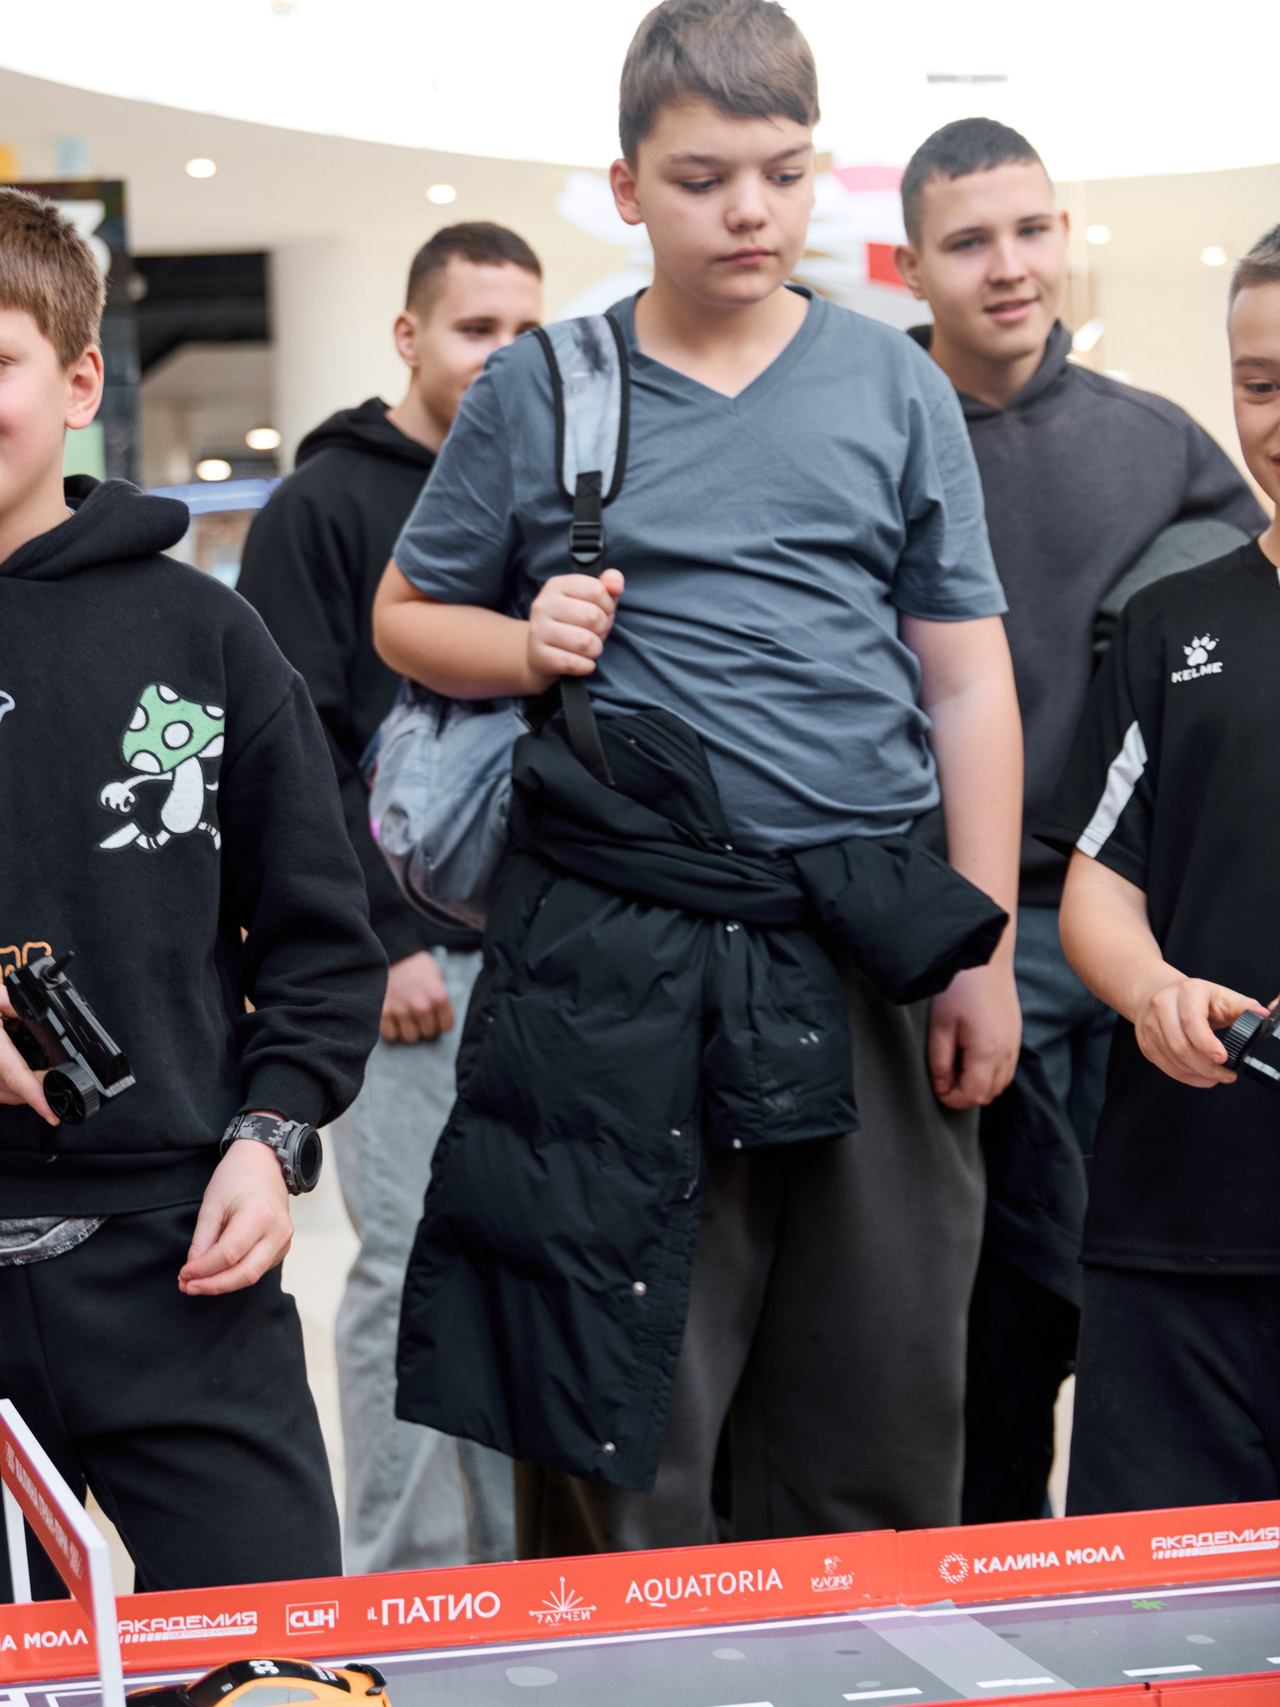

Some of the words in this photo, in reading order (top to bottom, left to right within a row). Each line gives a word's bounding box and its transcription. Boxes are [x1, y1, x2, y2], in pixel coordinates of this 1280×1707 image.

[1171, 661, 1223, 683] KELME
[1151, 1526, 1279, 1550] АКАДЕМИЯ
[973, 1551, 1061, 1575] КАЛИНА
[1065, 1545, 1126, 1566] МОЛЛ
[625, 1567, 784, 1607] AQUATORIA
[381, 1591, 501, 1626] ПАТИО
[118, 1611, 258, 1633] АКАДЕМИЯ
[23, 1628, 89, 1650] МОЛЛ
